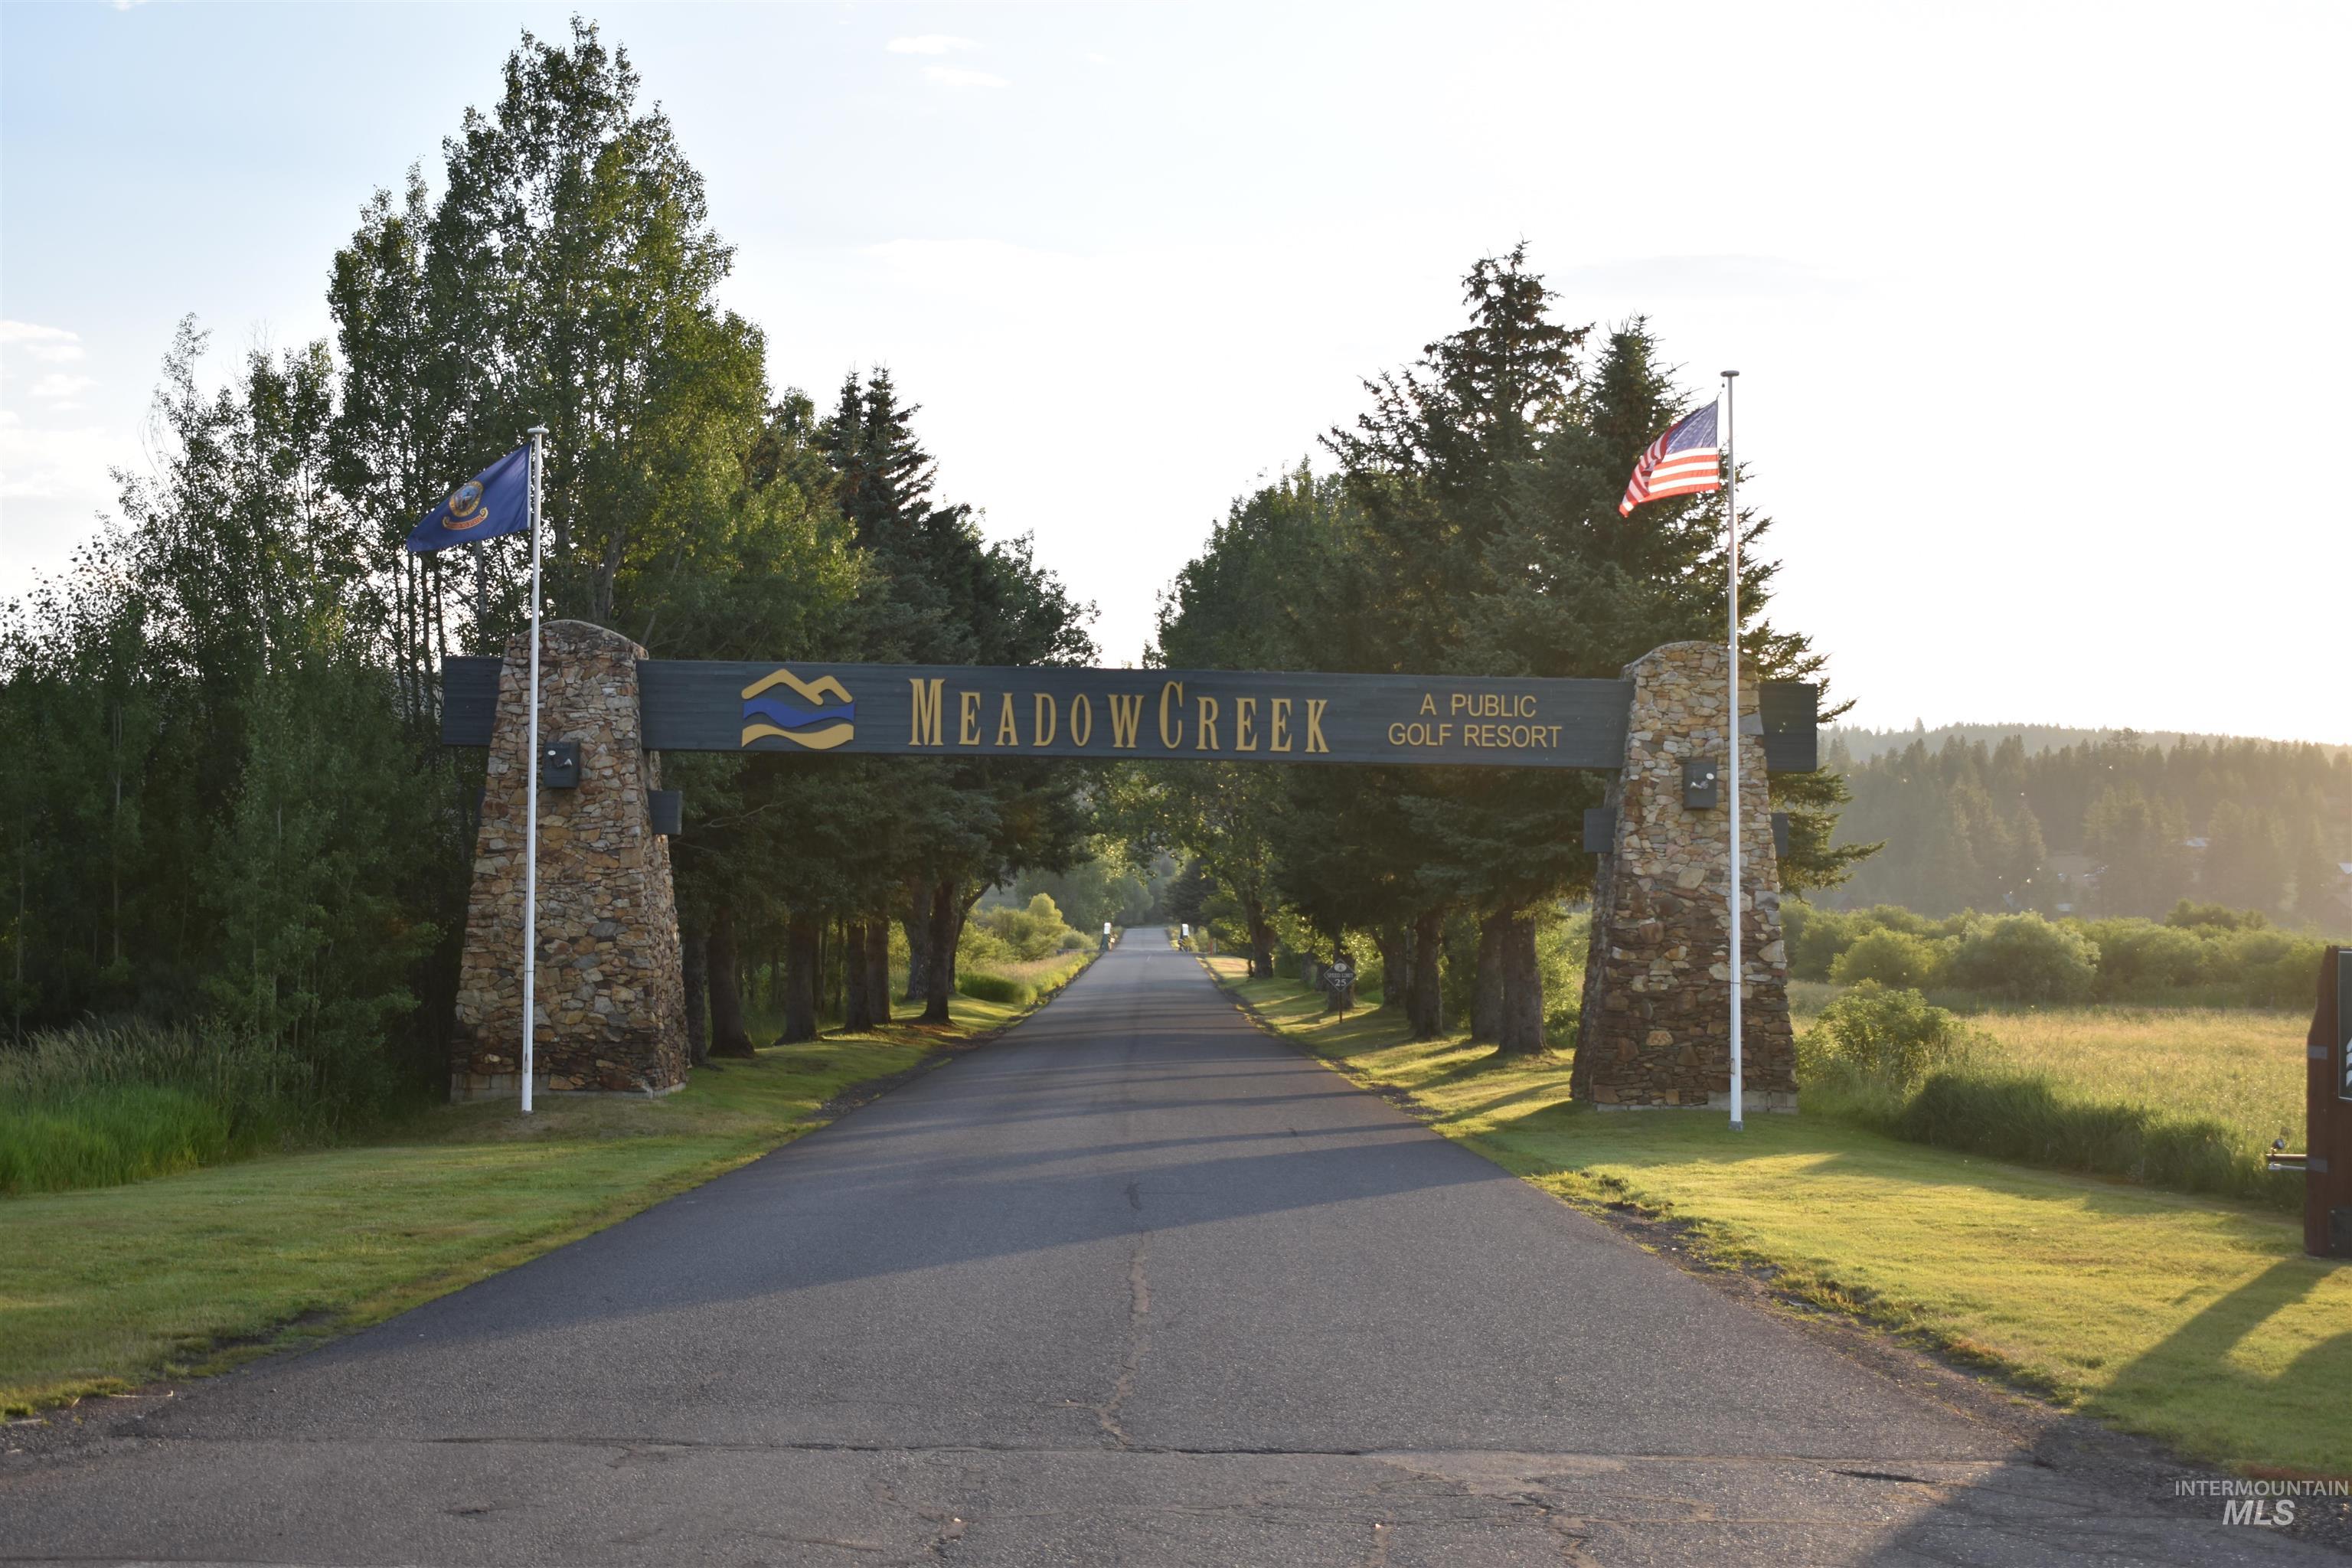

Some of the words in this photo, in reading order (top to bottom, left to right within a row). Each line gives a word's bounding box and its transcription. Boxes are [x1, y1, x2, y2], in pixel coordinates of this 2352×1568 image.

[1419, 693, 1437, 715] A
[1451, 693, 1537, 718] PUBLIC
[1387, 722, 1453, 746] GOLF
[1463, 724, 1563, 748] RESORT
